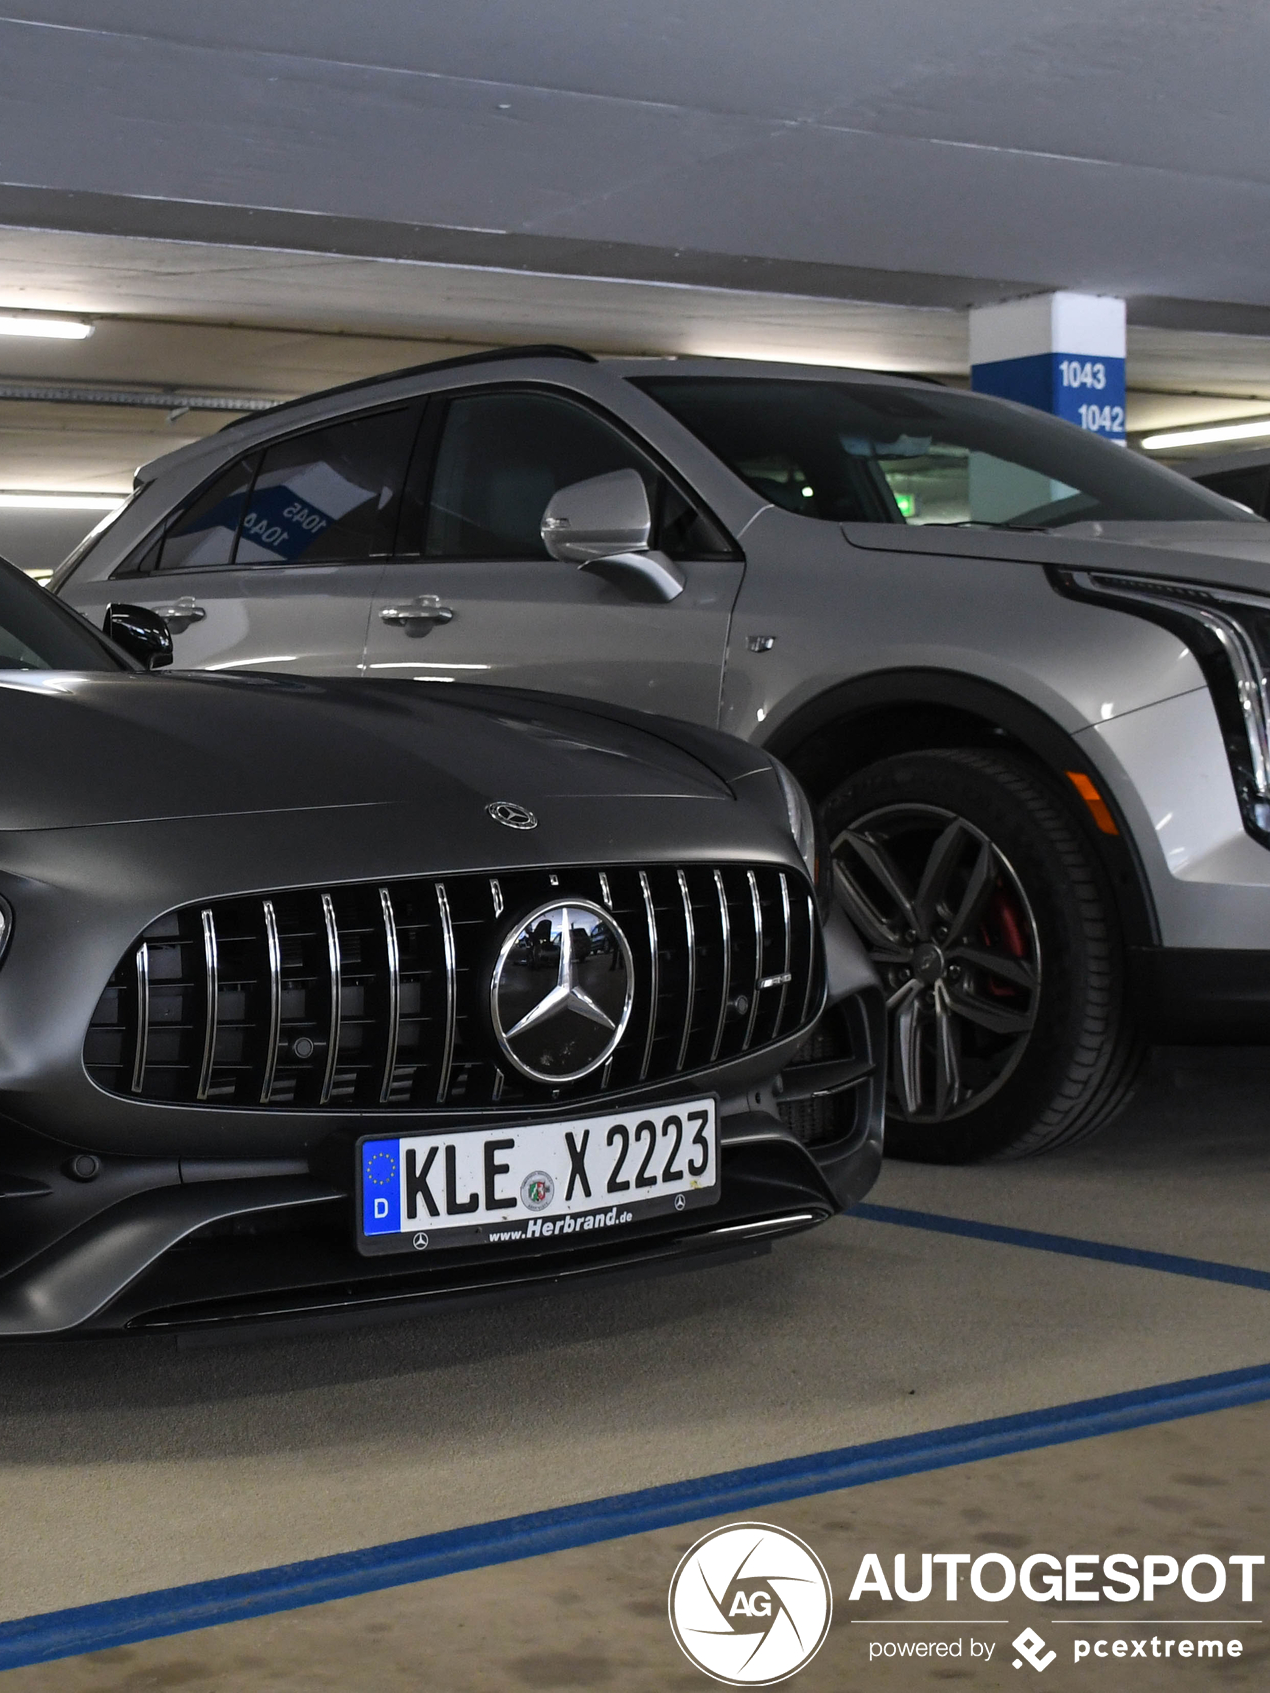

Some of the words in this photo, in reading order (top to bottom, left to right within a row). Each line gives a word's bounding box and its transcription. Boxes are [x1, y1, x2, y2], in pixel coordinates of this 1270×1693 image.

[1059, 360, 1106, 389] 1043
[1078, 404, 1124, 432] 1042
[405, 1138, 518, 1220] KLE
[563, 1129, 592, 1201] X
[606, 1109, 710, 1195] 2223
[373, 1198, 389, 1219] D
[489, 1207, 633, 1242] www.Herbrand.de
